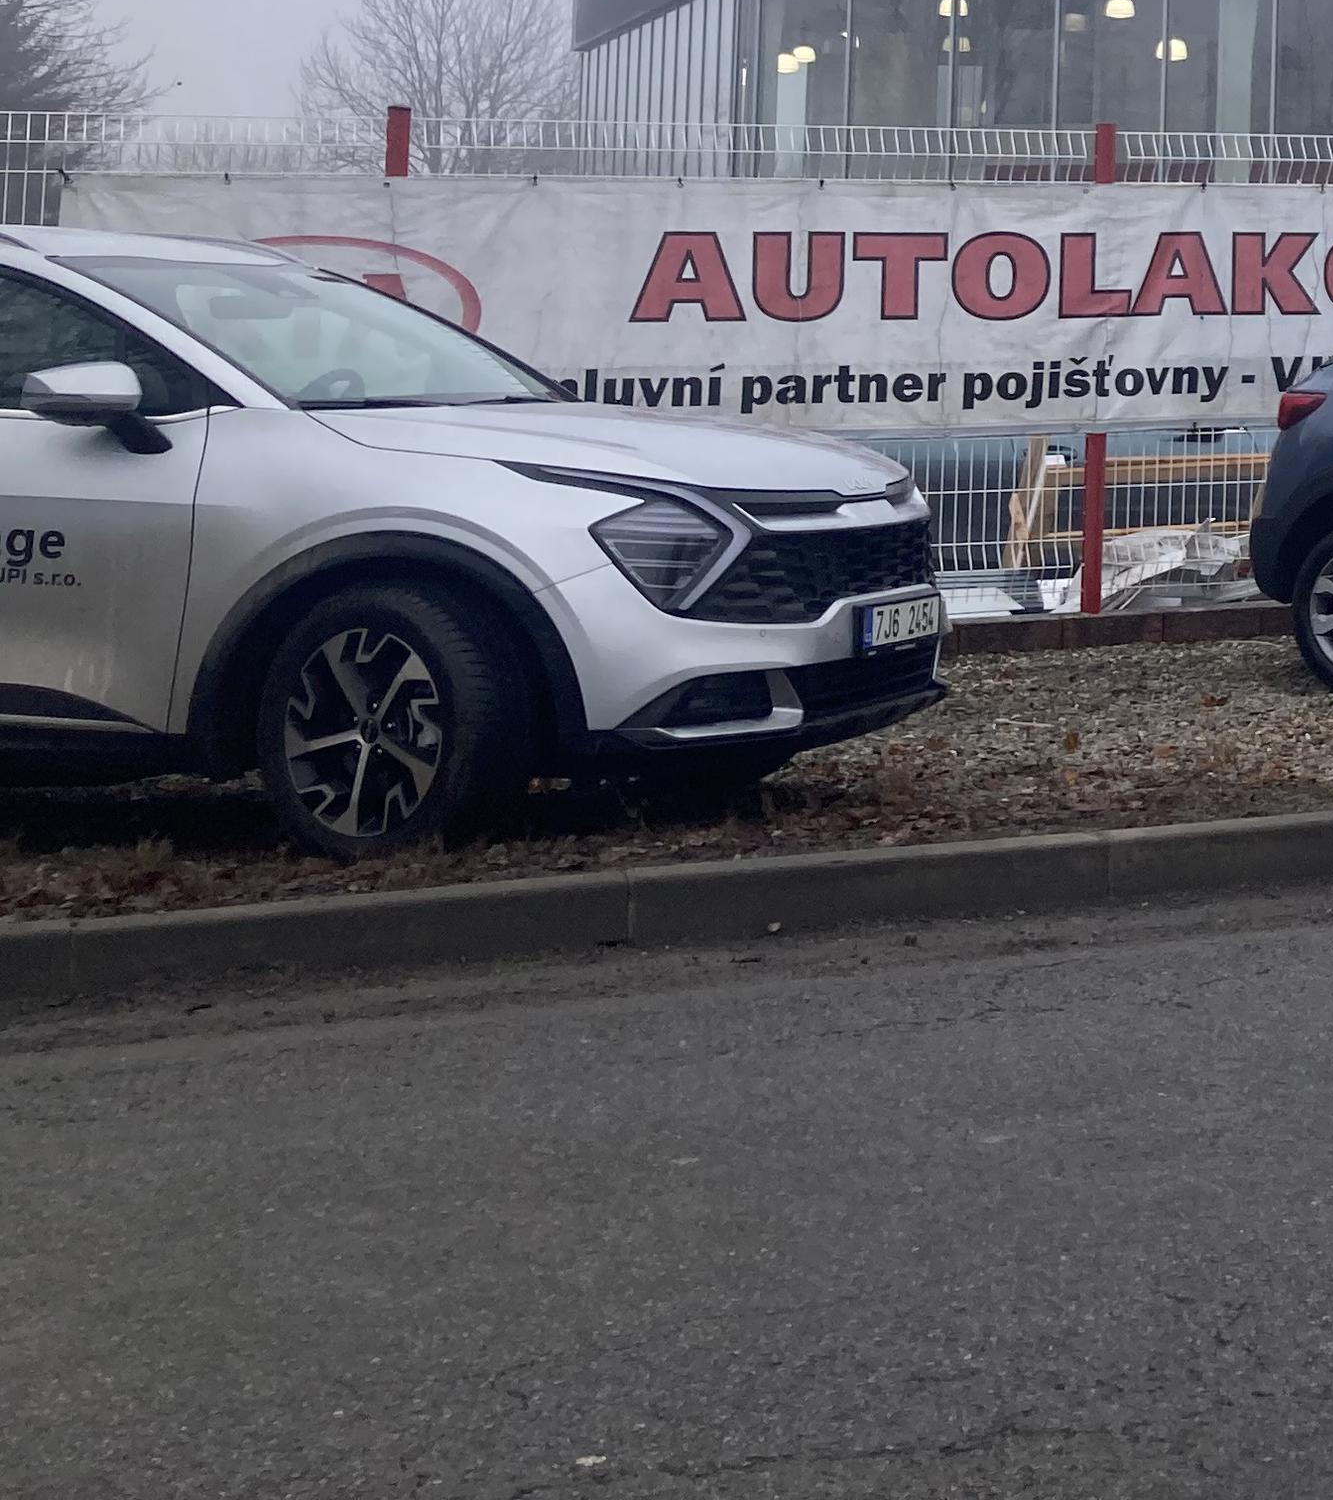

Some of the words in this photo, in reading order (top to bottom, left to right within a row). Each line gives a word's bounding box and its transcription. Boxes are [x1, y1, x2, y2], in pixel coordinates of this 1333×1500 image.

[741, 366, 946, 414] partner
[962, 355, 1229, 410] pojišťovny
[33, 572, 82, 587] s.r.o.
[875, 608, 900, 641] 7J6
[907, 600, 935, 636] 2454
